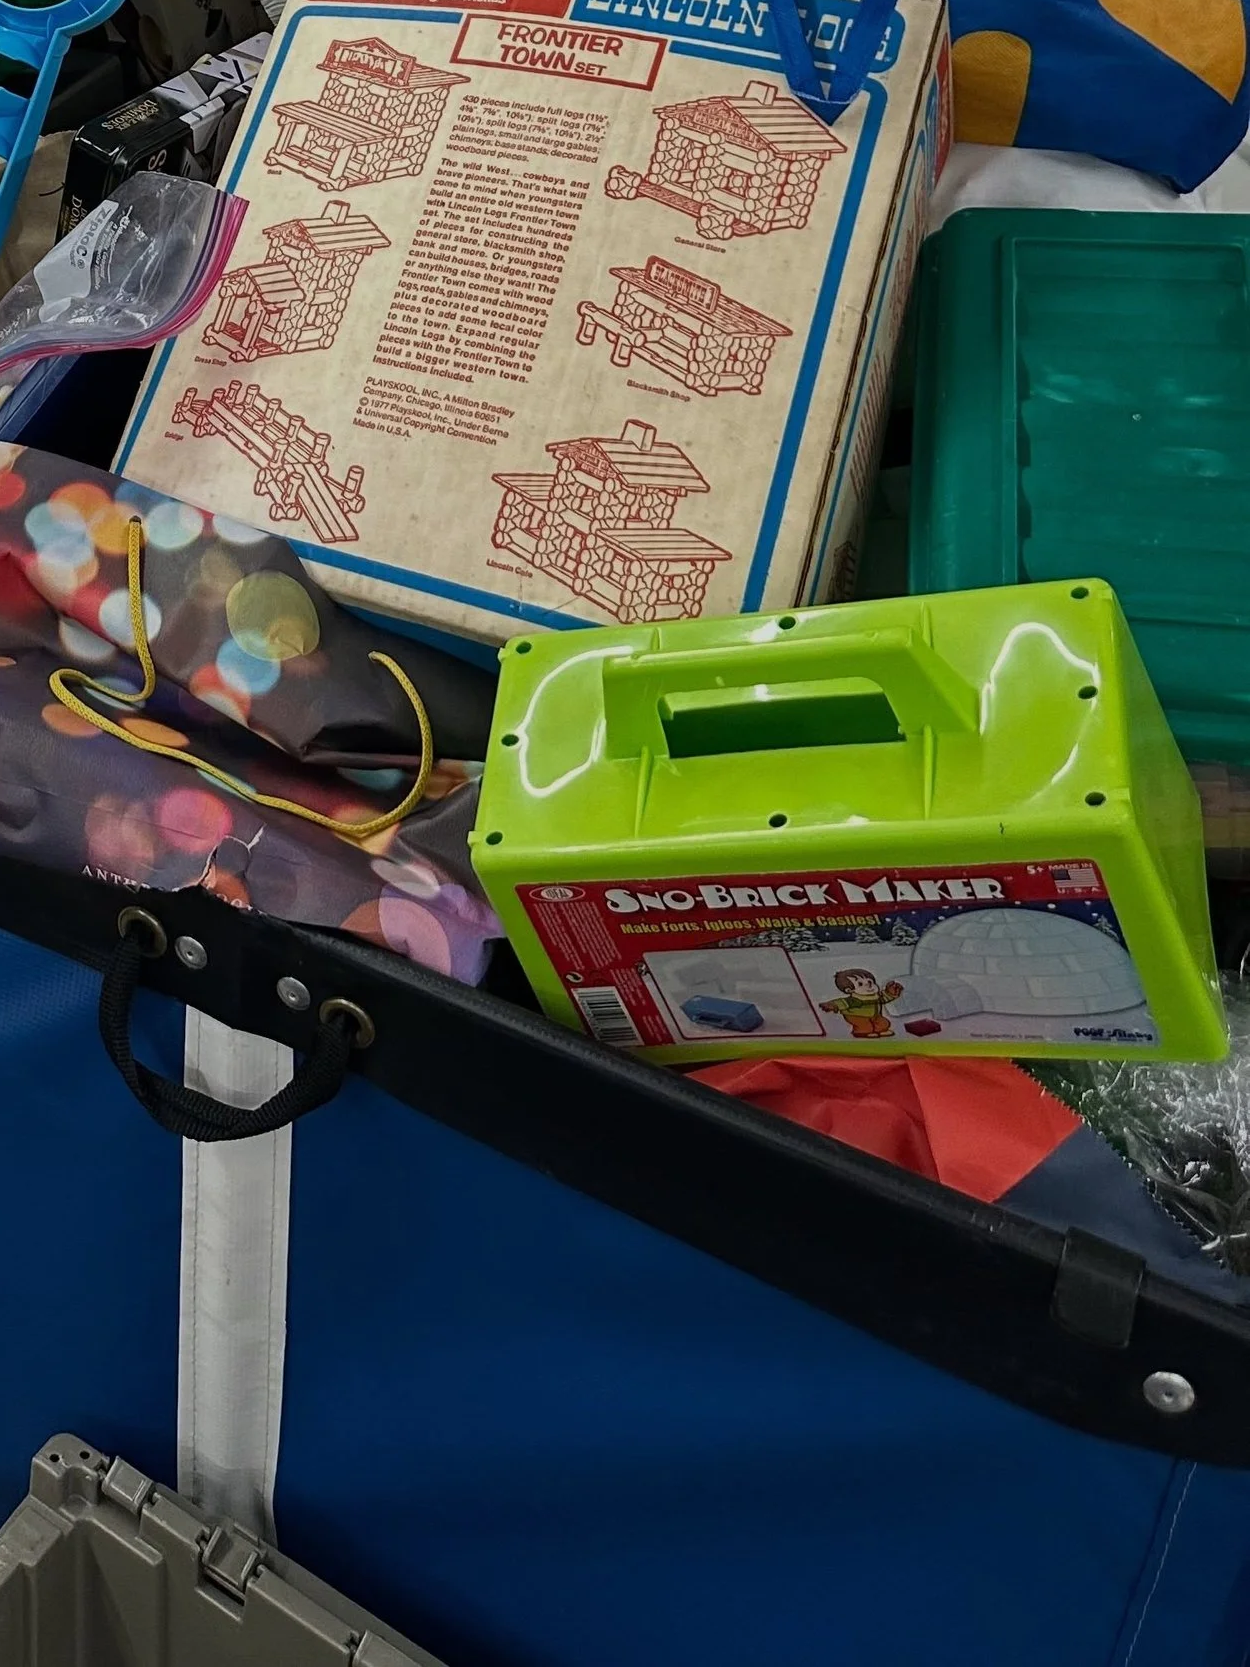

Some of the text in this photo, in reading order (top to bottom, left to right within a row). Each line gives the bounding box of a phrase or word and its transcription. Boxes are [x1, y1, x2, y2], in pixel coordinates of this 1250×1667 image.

[498, 22, 623, 57] FRONTIER
[500, 43, 608, 76] TOWN SET
[101, 98, 158, 131] DOMINOES
[463, 95, 584, 120] 430 pieces include full logs
[436, 167, 463, 179] brave
[512, 179, 541, 191] That's
[543, 186, 568, 196] what
[569, 191, 587, 200] will
[441, 157, 458, 167] The
[463, 162, 482, 171] wild
[570, 180, 590, 190] and
[430, 188, 454, 198] build
[468, 195, 497, 205] entire
[498, 200, 514, 208] old
[515, 203, 554, 215] western
[555, 209, 579, 220] town
[433, 179, 583, 210] come to mind when youngsters
[426, 198, 576, 231] with Lincoln Logs Frontier Town
[444, 211, 462, 221] The
[464, 216, 480, 224] set
[482, 217, 523, 232] includes
[526, 225, 573, 242] hundreds
[415, 229, 452, 241] general
[483, 239, 536, 256] blacksmith
[433, 221, 465, 232] pieces
[470, 226, 484, 235] for
[488, 231, 548, 249] constructing
[553, 242, 570, 252] the
[674, 236, 727, 254] General Store
[443, 394, 450, 402] A
[451, 395, 480, 409] Milton
[481, 401, 515, 418] Bradley
[626, 379, 691, 403] Blacksmith Shop
[353, 417, 376, 430] Made
[376, 422, 385, 432] in
[364, 408, 403, 423] Universal
[403, 417, 446, 433] Copyright
[447, 427, 497, 446] Convention
[371, 399, 390, 409] 1977
[454, 418, 481, 431] Under
[444, 404, 473, 417] Illinois
[474, 411, 500, 424] 60651
[486, 558, 514, 573] Lincoln
[1026, 864, 1044, 875] 5+
[1048, 863, 1079, 871] MADE
[544, 887, 571, 900] IDEAL
[604, 875, 1005, 914] SNO-BRICK MAKER
[620, 922, 661, 935] Make
[757, 915, 798, 930] Walls
[804, 917, 814, 929] &
[816, 912, 880, 928] Castles!
